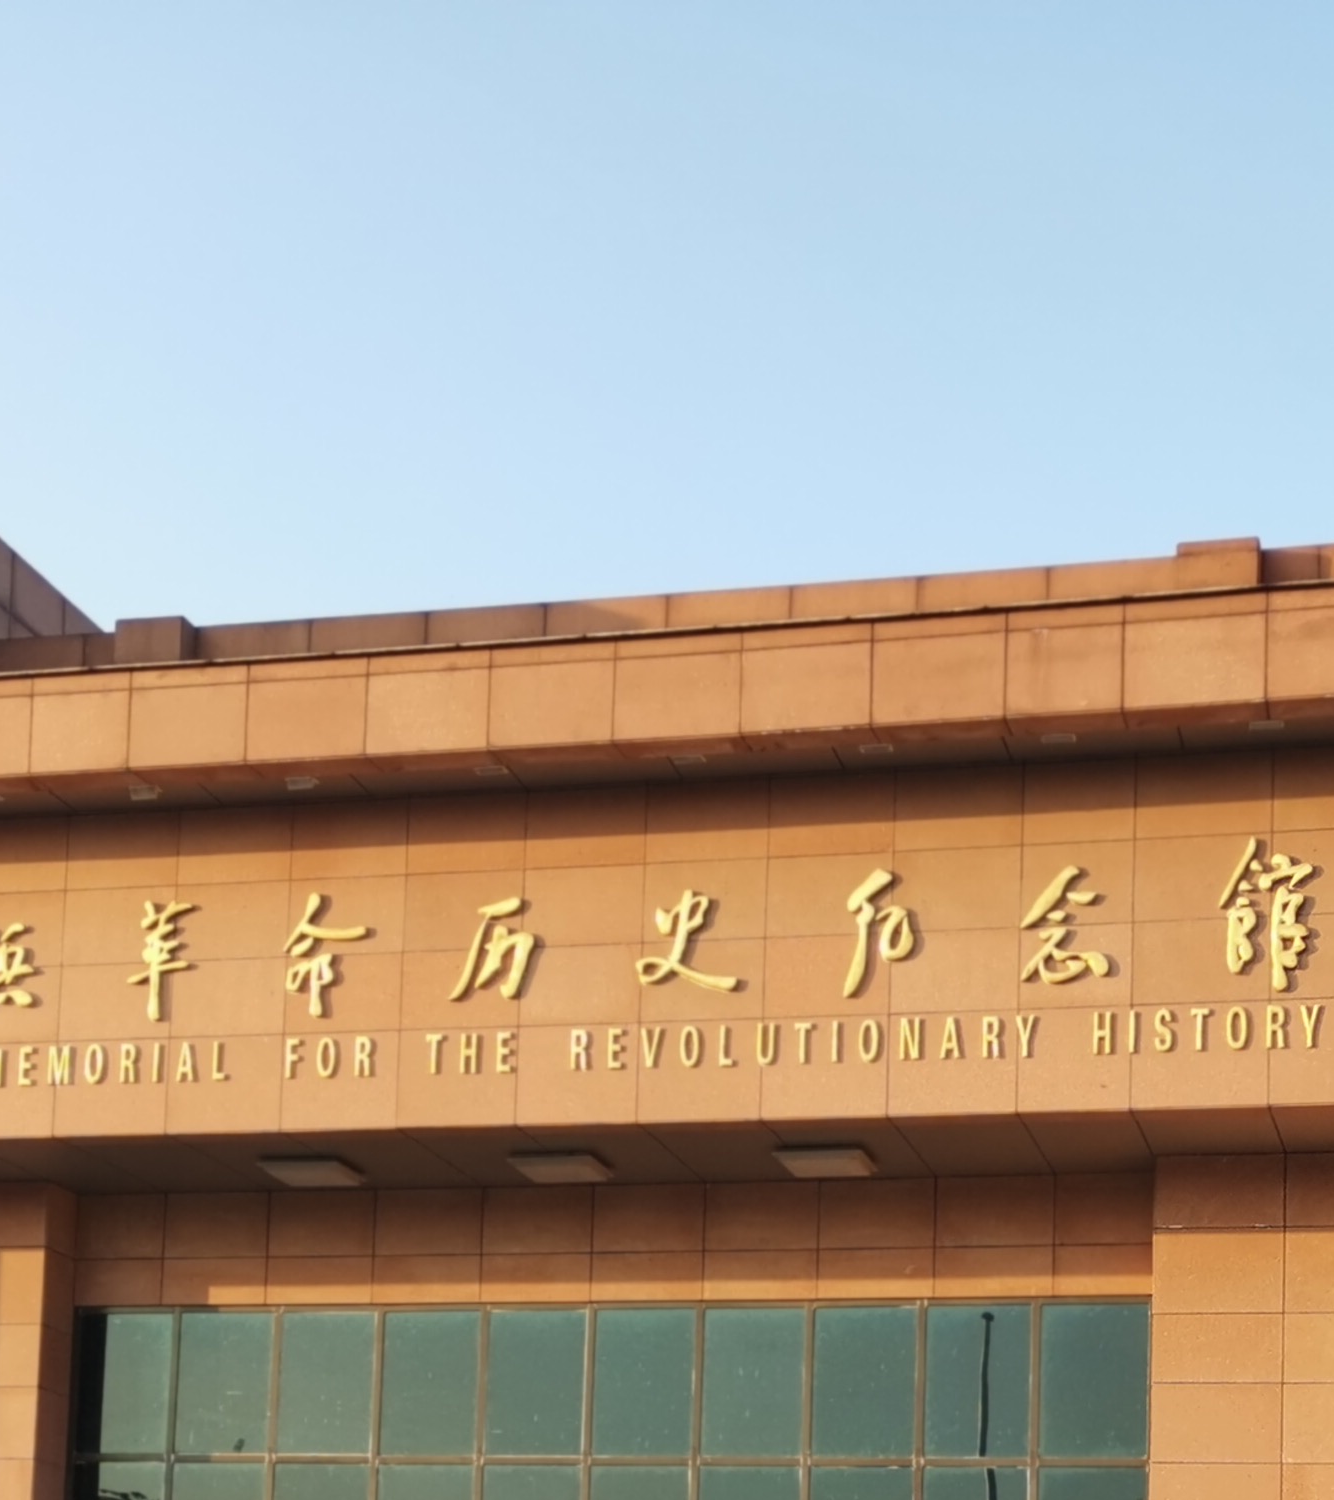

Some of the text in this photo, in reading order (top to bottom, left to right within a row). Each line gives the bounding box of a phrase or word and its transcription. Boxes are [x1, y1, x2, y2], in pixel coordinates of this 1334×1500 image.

[283, 1034, 375, 1080] FOR
[424, 1030, 517, 1075] THE
[569, 1012, 1038, 1072] REVOLUTIONARY
[1092, 1002, 1322, 1055] HISTORY
